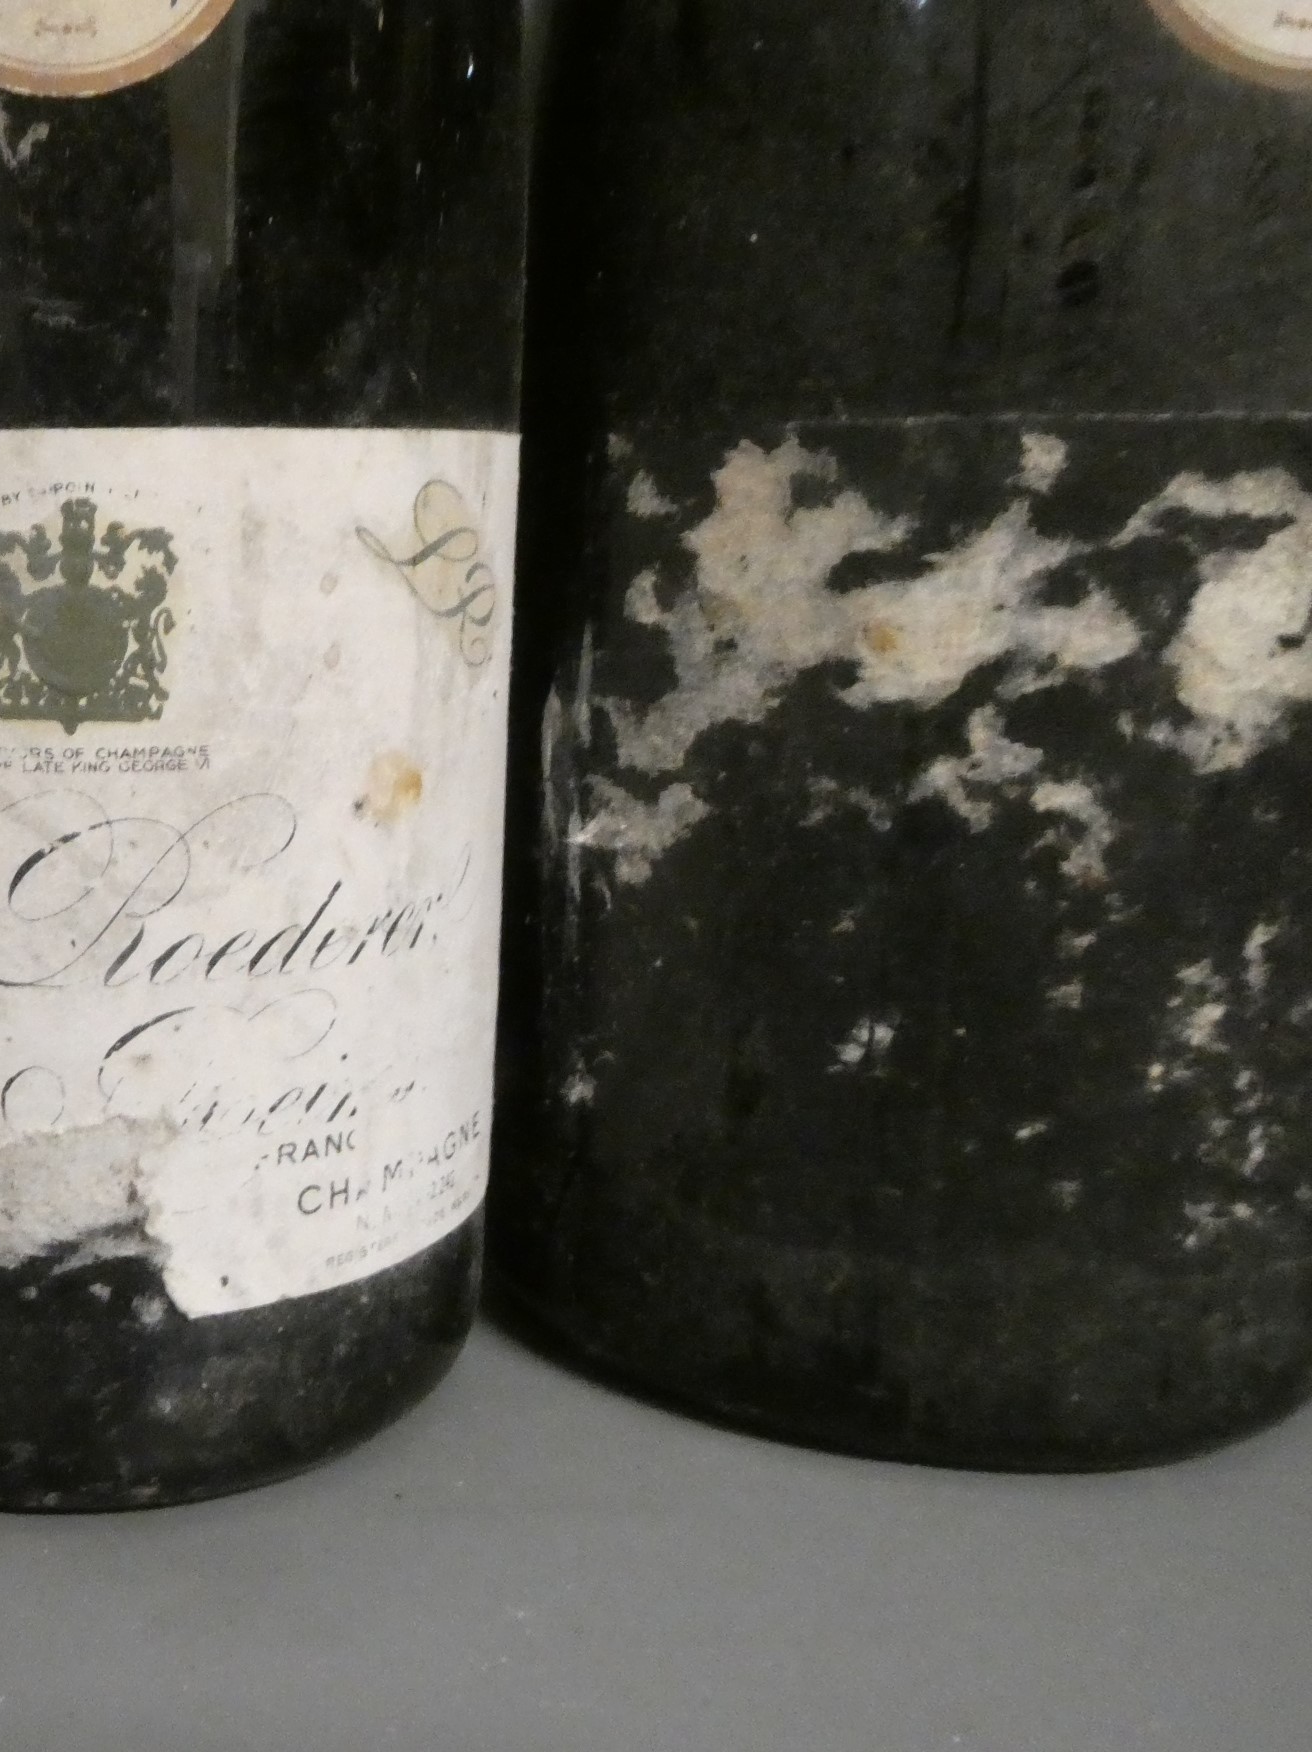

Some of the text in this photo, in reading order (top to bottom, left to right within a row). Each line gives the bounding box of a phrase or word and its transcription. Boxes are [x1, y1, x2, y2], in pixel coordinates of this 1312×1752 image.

[63, 746, 85, 760] OF
[22, 759, 65, 773] LATE
[71, 759, 111, 773] KING
[118, 758, 188, 773] GEORGE
